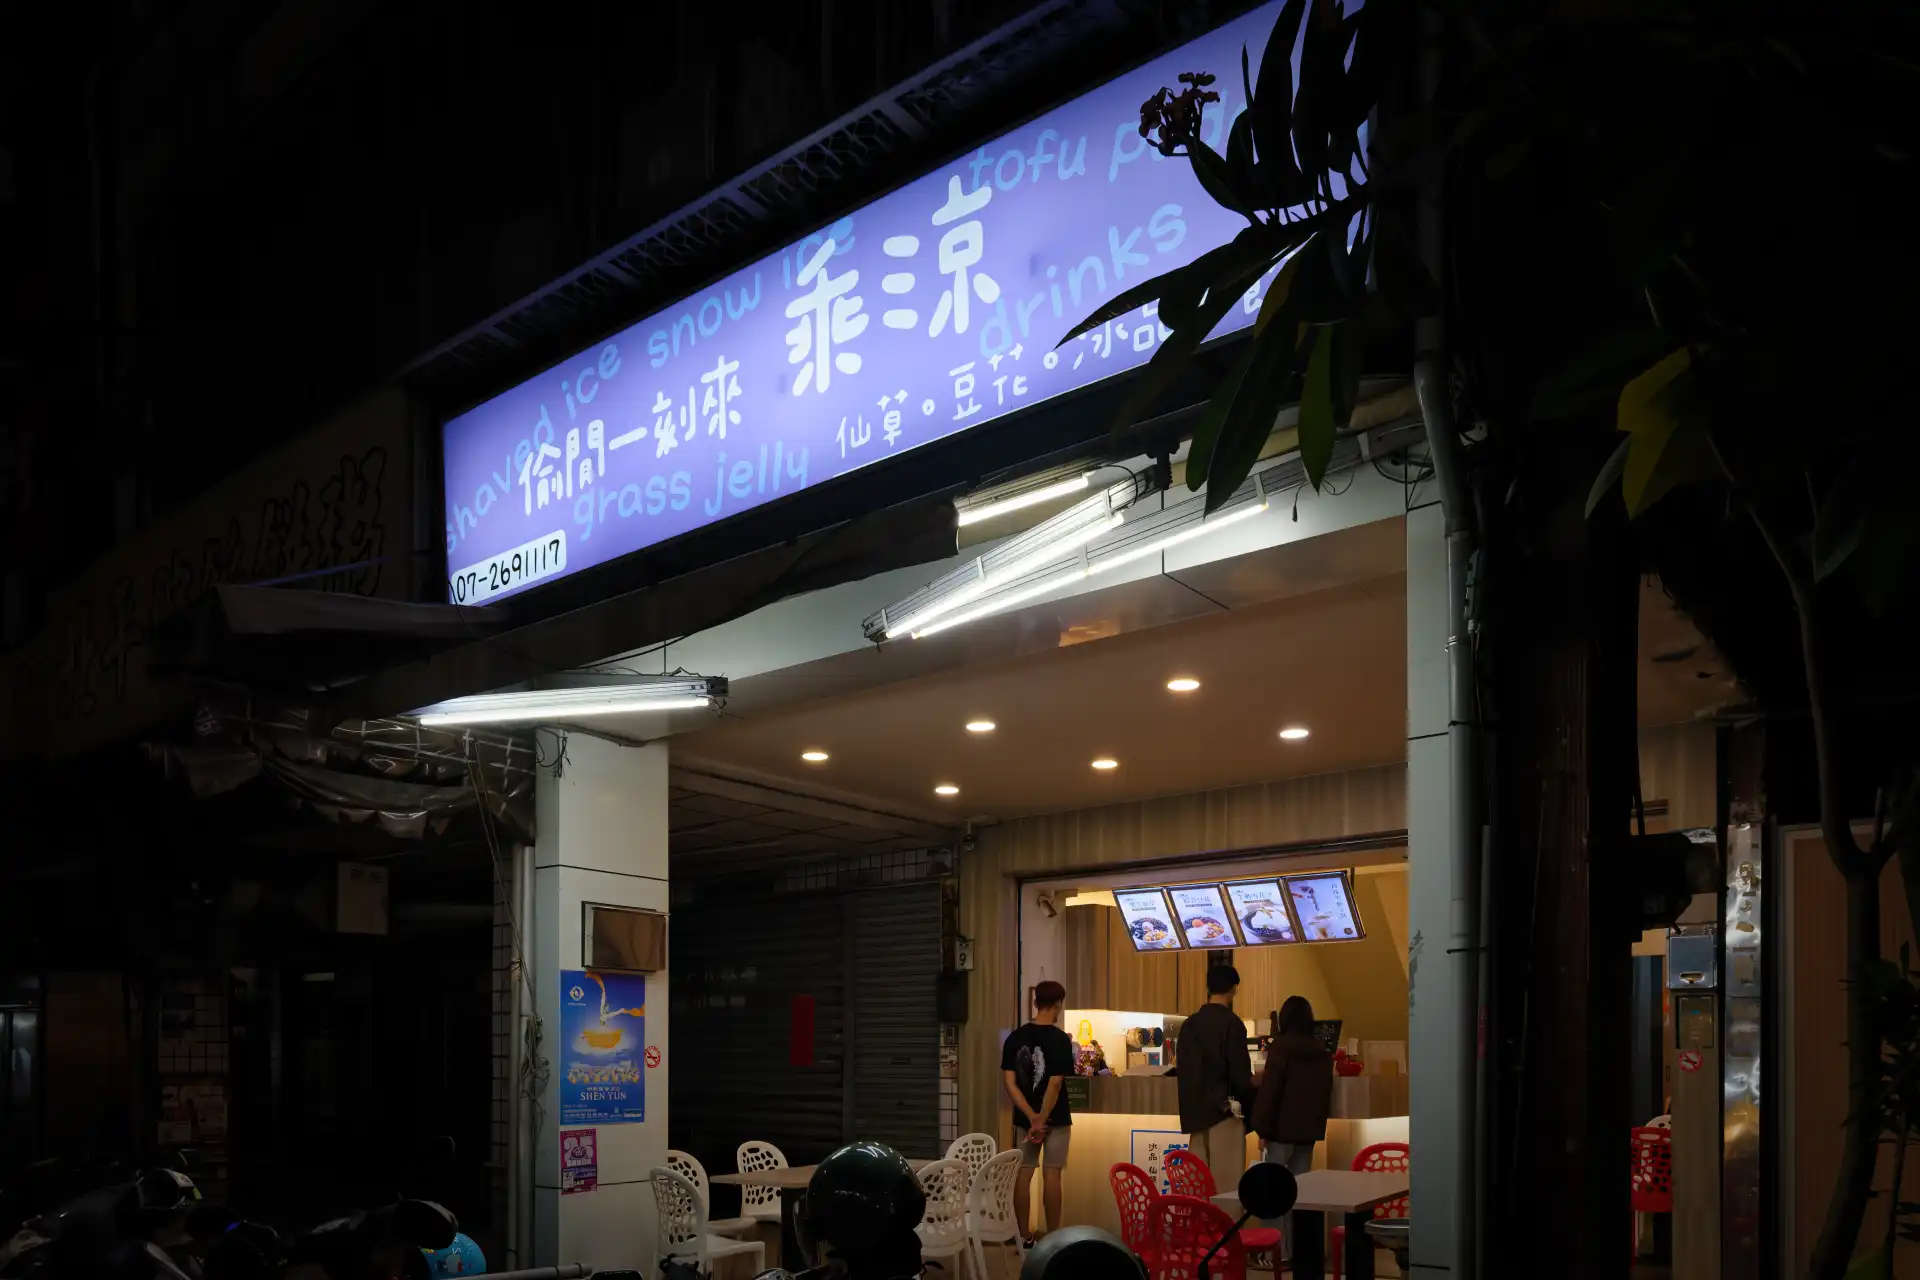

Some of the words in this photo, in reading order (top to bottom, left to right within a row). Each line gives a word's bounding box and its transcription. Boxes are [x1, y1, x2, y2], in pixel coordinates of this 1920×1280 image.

[968, 128, 1087, 192] tofu
[648, 271, 761, 369] snow
[979, 202, 1188, 358] drinks
[447, 403, 555, 555] shaved
[561, 343, 620, 421] ice
[573, 469, 692, 542] grass
[704, 440, 809, 518] jelly
[455, 538, 561, 604] 07-2691117
[580, 1091, 606, 1101] SHEN
[608, 1090, 627, 1101] YUN
